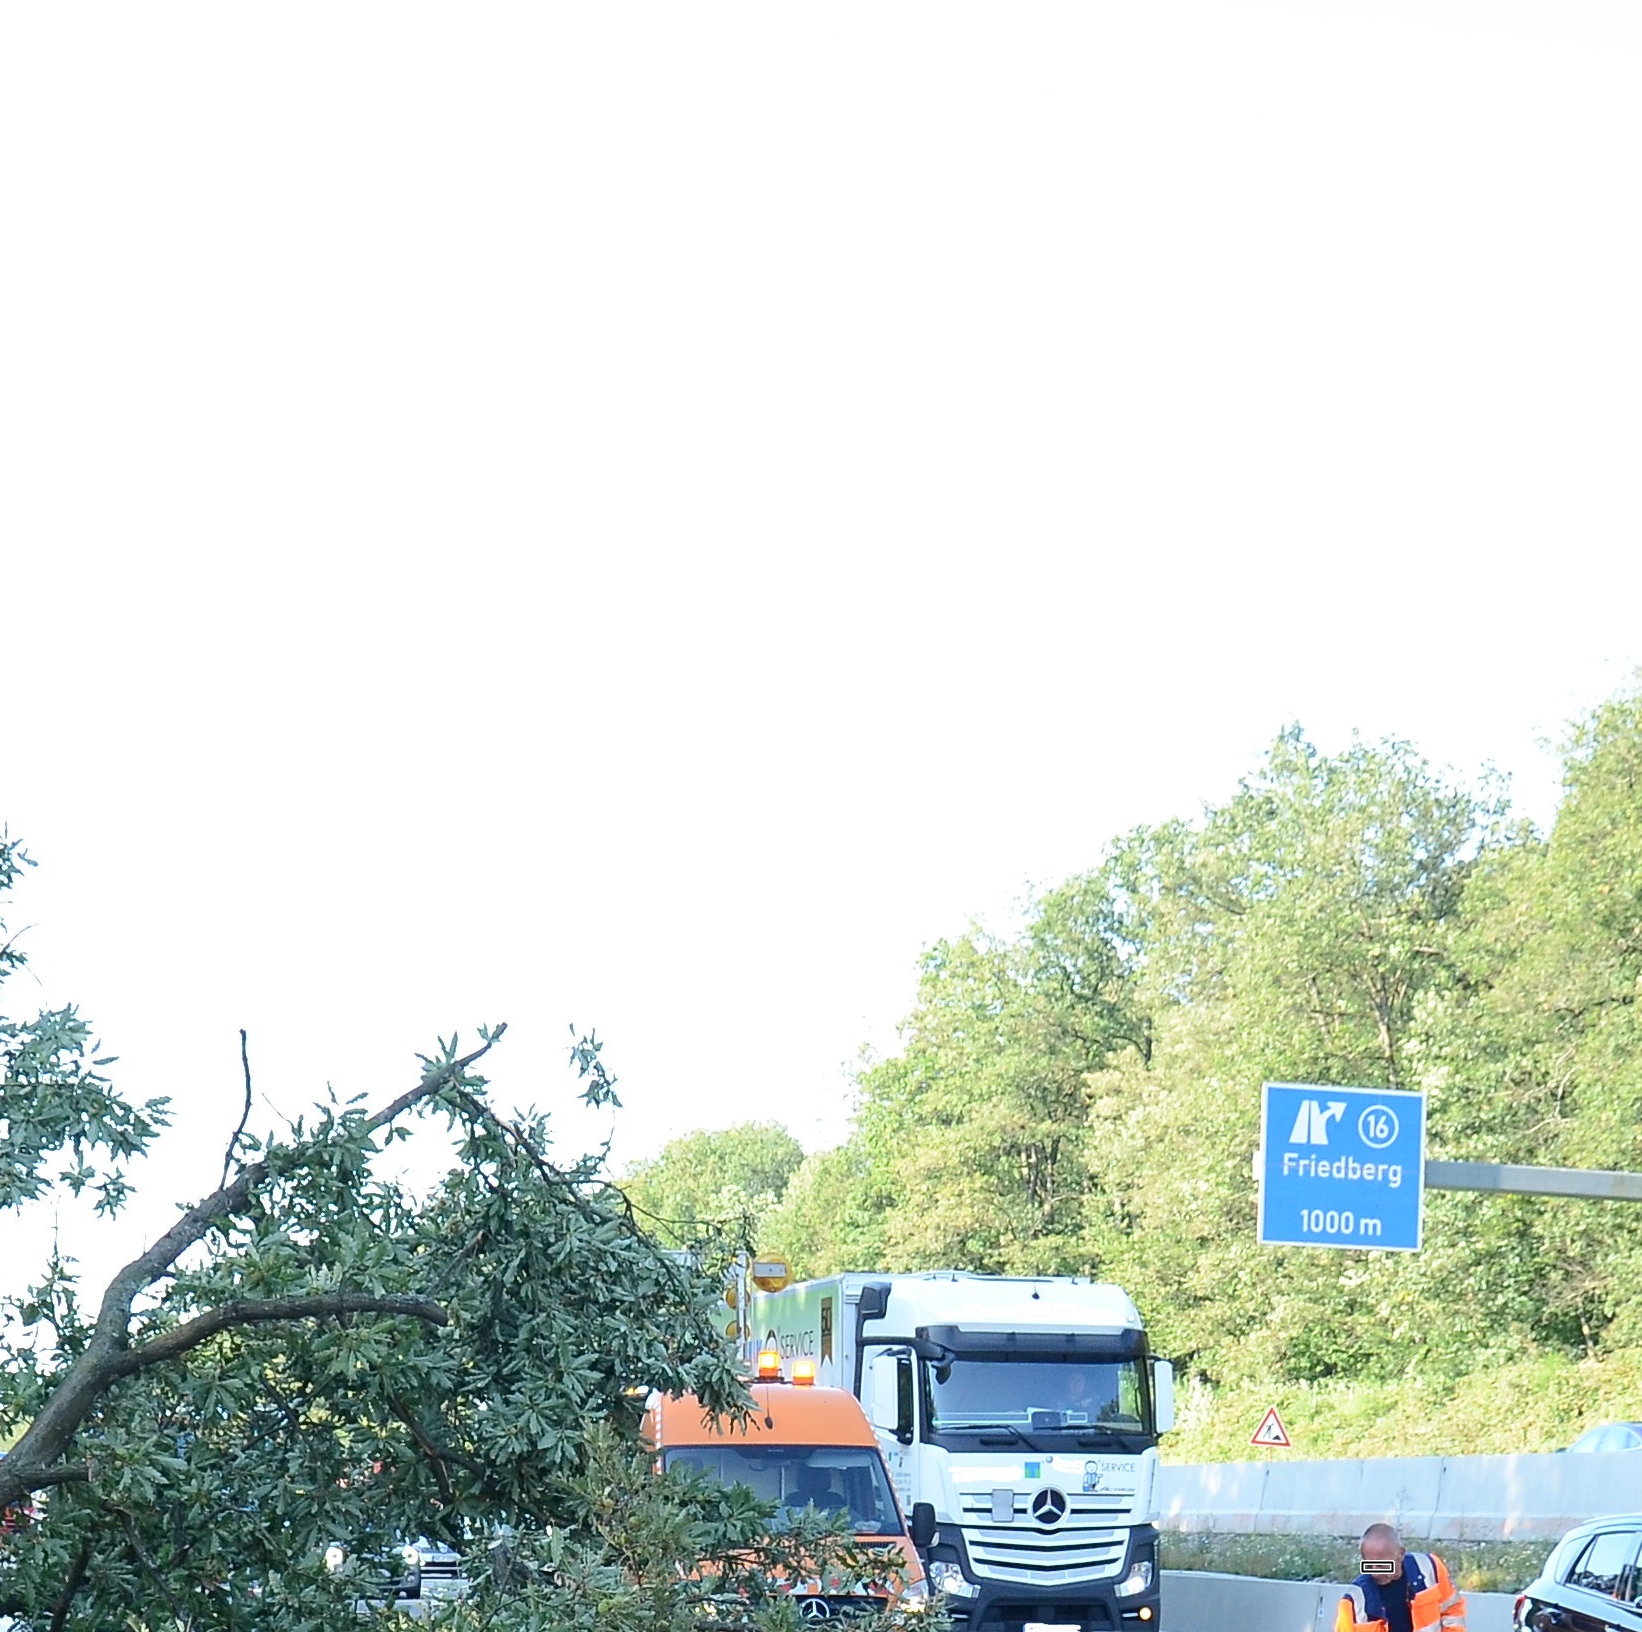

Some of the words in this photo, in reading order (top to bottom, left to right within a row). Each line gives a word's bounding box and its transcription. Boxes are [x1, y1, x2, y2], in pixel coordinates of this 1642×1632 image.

[1366, 1114, 1389, 1139] 16
[1283, 1152, 1402, 1188] Friedberg
[1300, 1209, 1354, 1235] 1000
[1360, 1217, 1381, 1236] m
[779, 1330, 814, 1360] SERVICE
[1101, 1462, 1135, 1473] SERVICE
